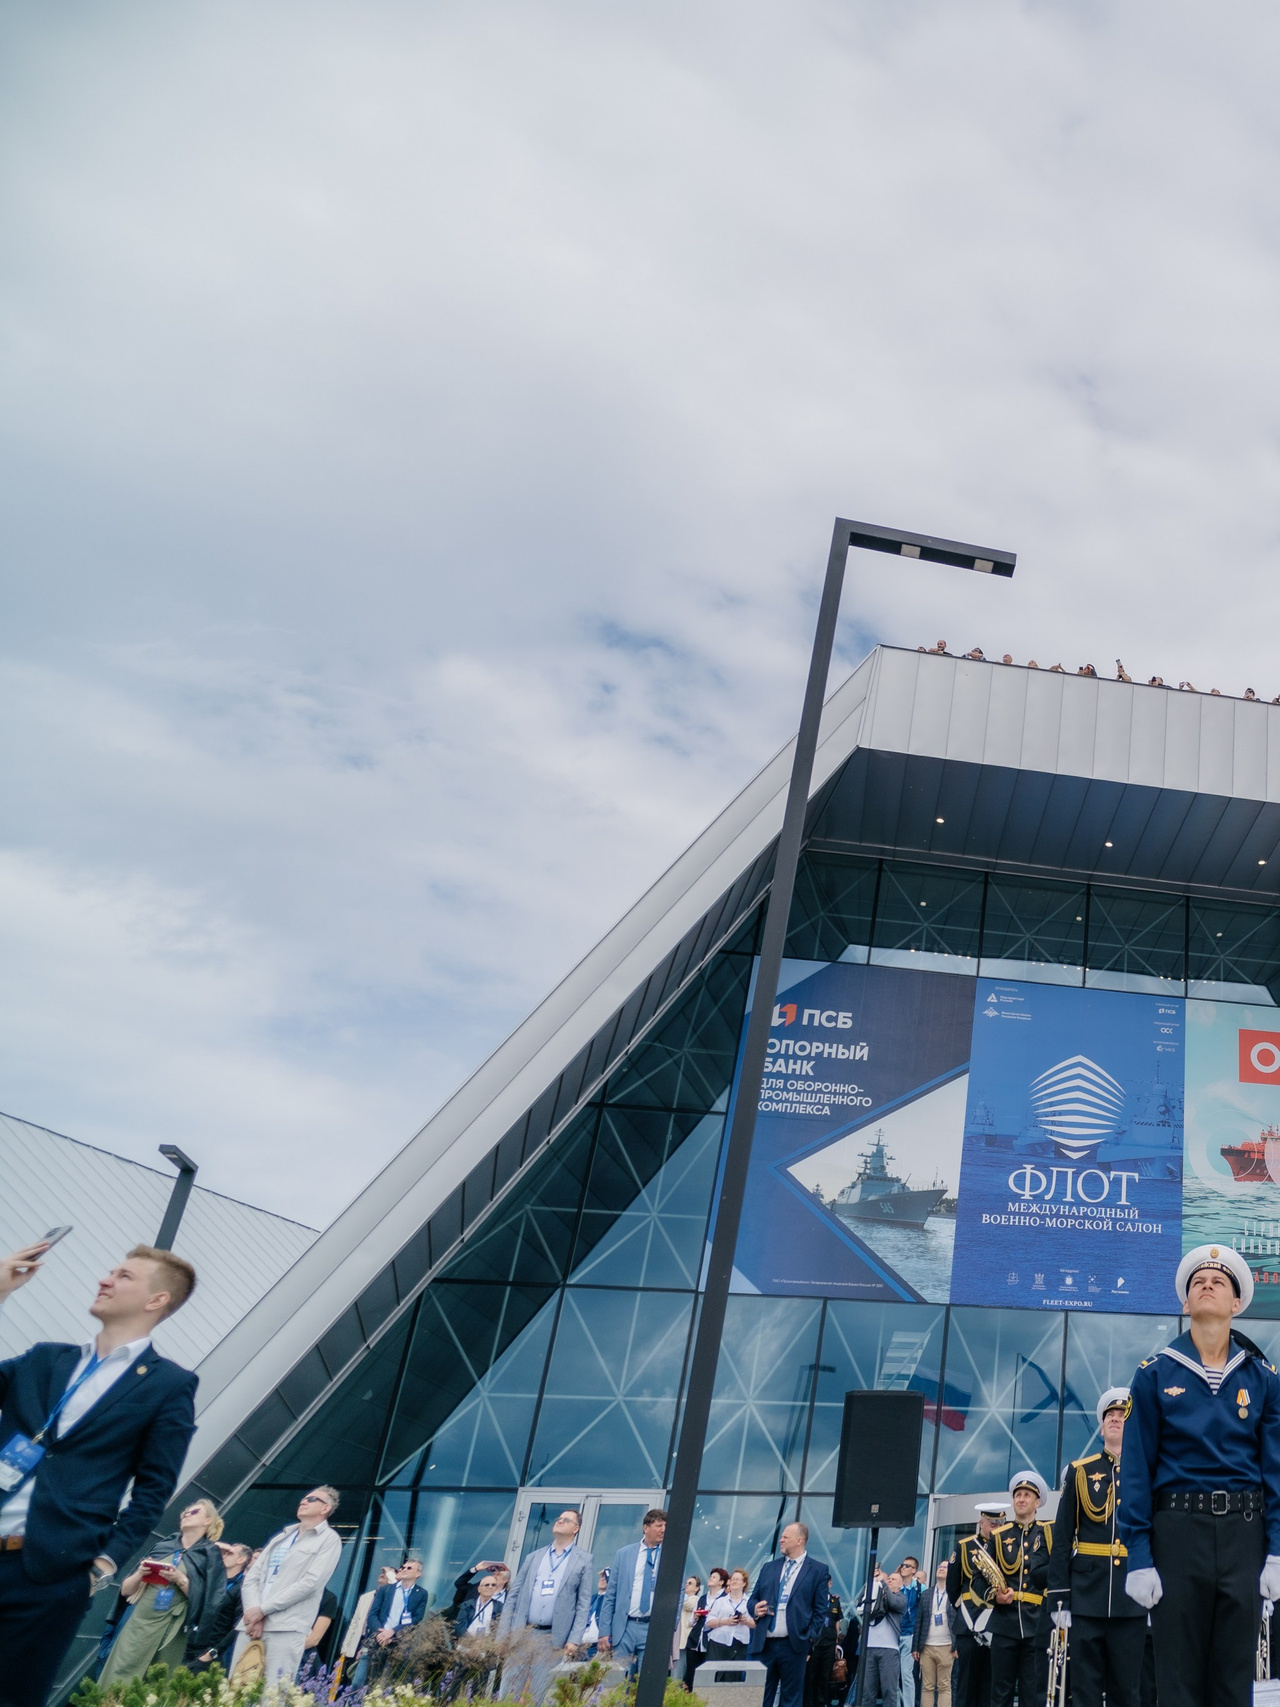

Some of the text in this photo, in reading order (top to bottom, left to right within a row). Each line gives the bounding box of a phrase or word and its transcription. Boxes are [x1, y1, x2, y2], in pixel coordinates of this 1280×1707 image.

[802, 1008, 853, 1029] ПСБ
[766, 1038, 869, 1061] ОПОРНЫЙ
[763, 1057, 816, 1076] БАНК
[787, 1080, 864, 1094] ОБОРОННО-
[1008, 1164, 1139, 1205] ФЛОТ
[1007, 1202, 1139, 1220] МЕЖДУНАРОДНЫЙ
[981, 1214, 1162, 1234] ВОЕННО-МОРСКОЙ САЛОН
[1042, 1299, 1093, 1307] FLEET-EXPO.RU
